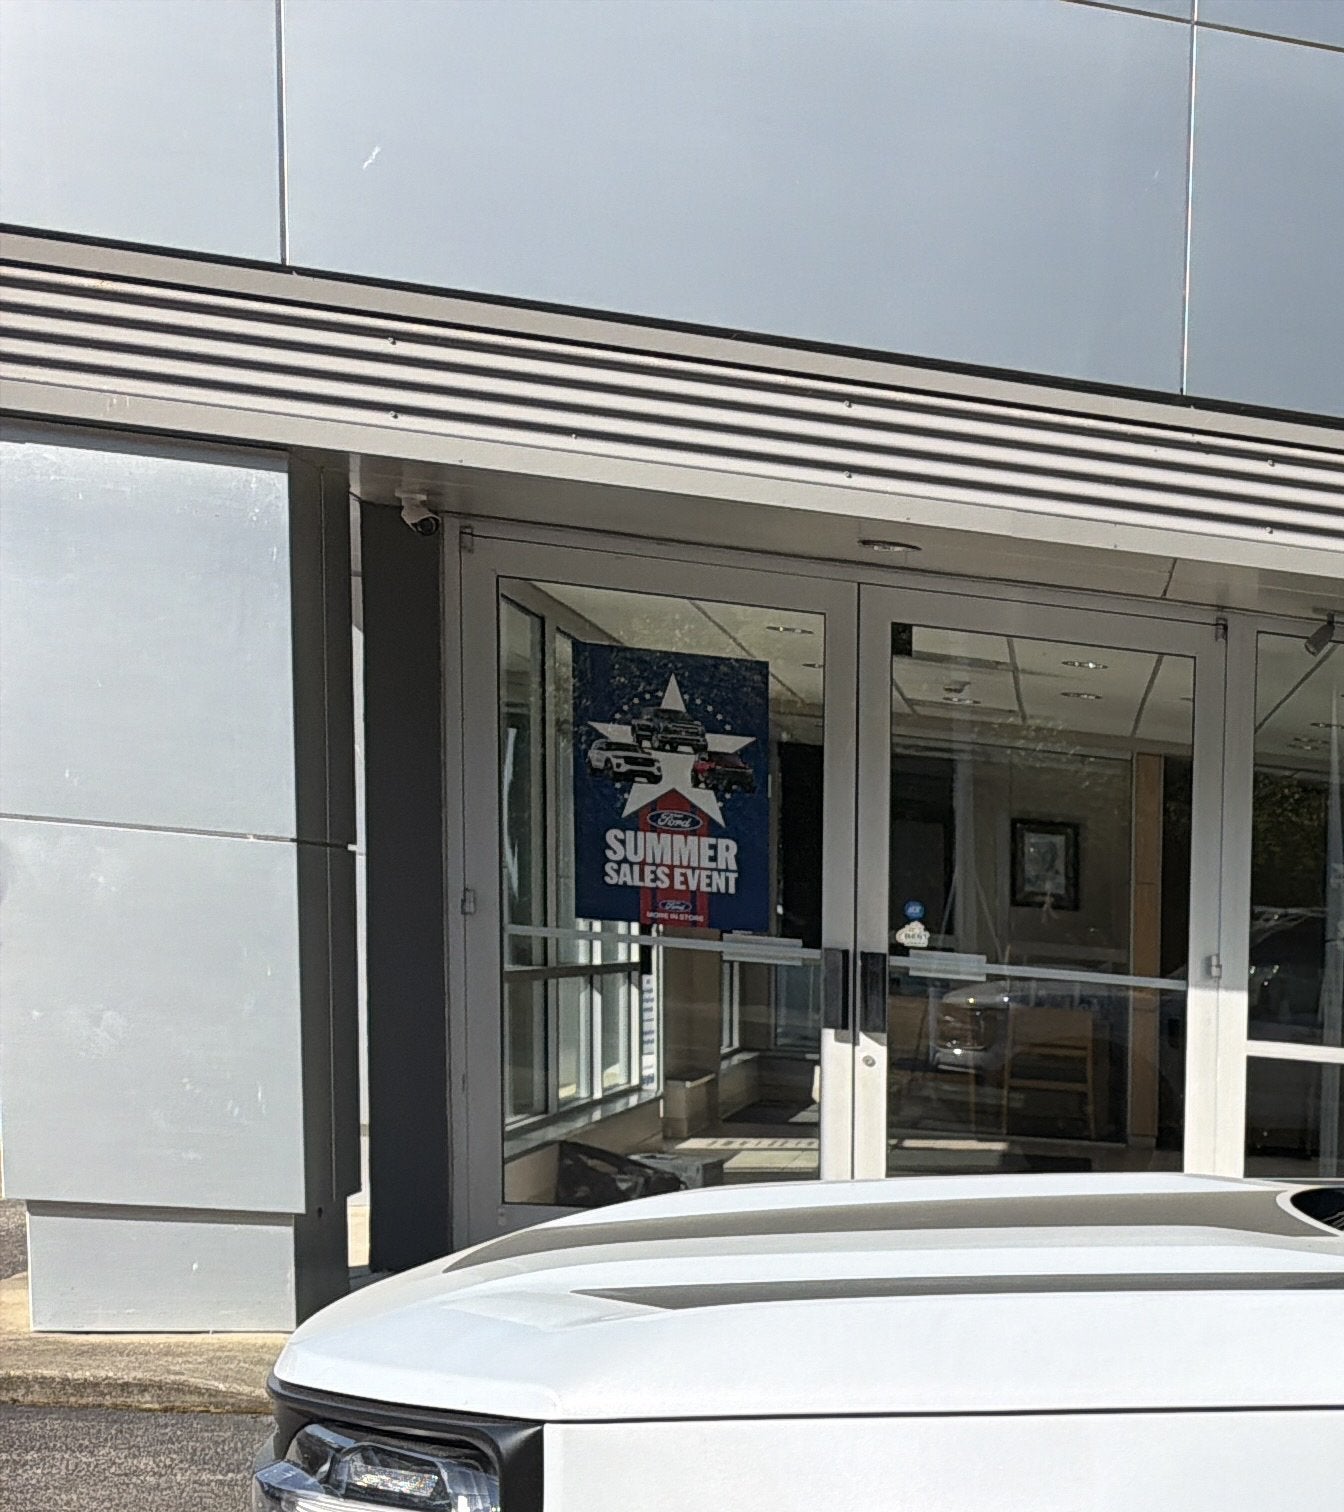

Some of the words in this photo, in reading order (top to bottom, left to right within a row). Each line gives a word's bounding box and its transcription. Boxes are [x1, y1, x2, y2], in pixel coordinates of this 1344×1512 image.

[604, 829, 738, 870] SUMMER
[604, 861, 670, 889] SALES
[673, 867, 739, 894] EVENT
